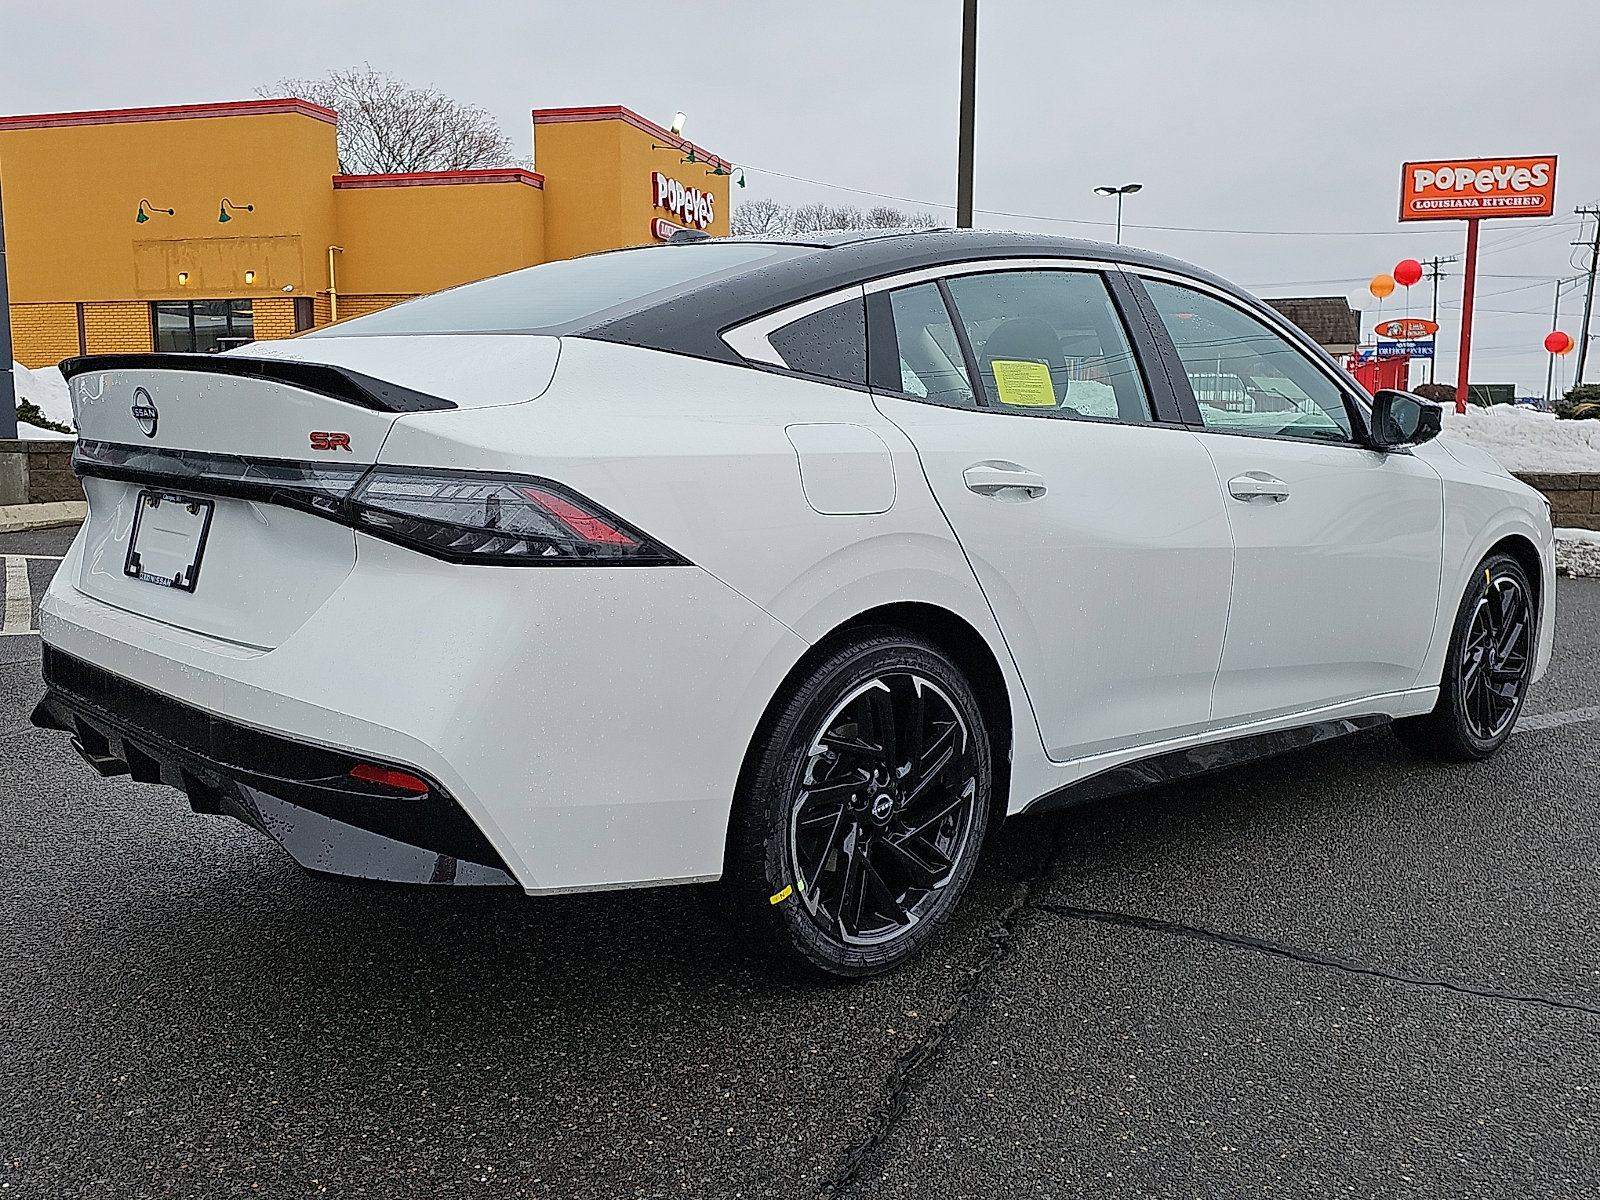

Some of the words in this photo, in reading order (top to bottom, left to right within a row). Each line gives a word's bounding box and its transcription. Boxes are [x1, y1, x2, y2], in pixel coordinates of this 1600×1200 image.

[1416, 199, 1479, 209] LOUISIANA
[1482, 197, 1540, 207] KITCHEN
[310, 432, 352, 451] SR
